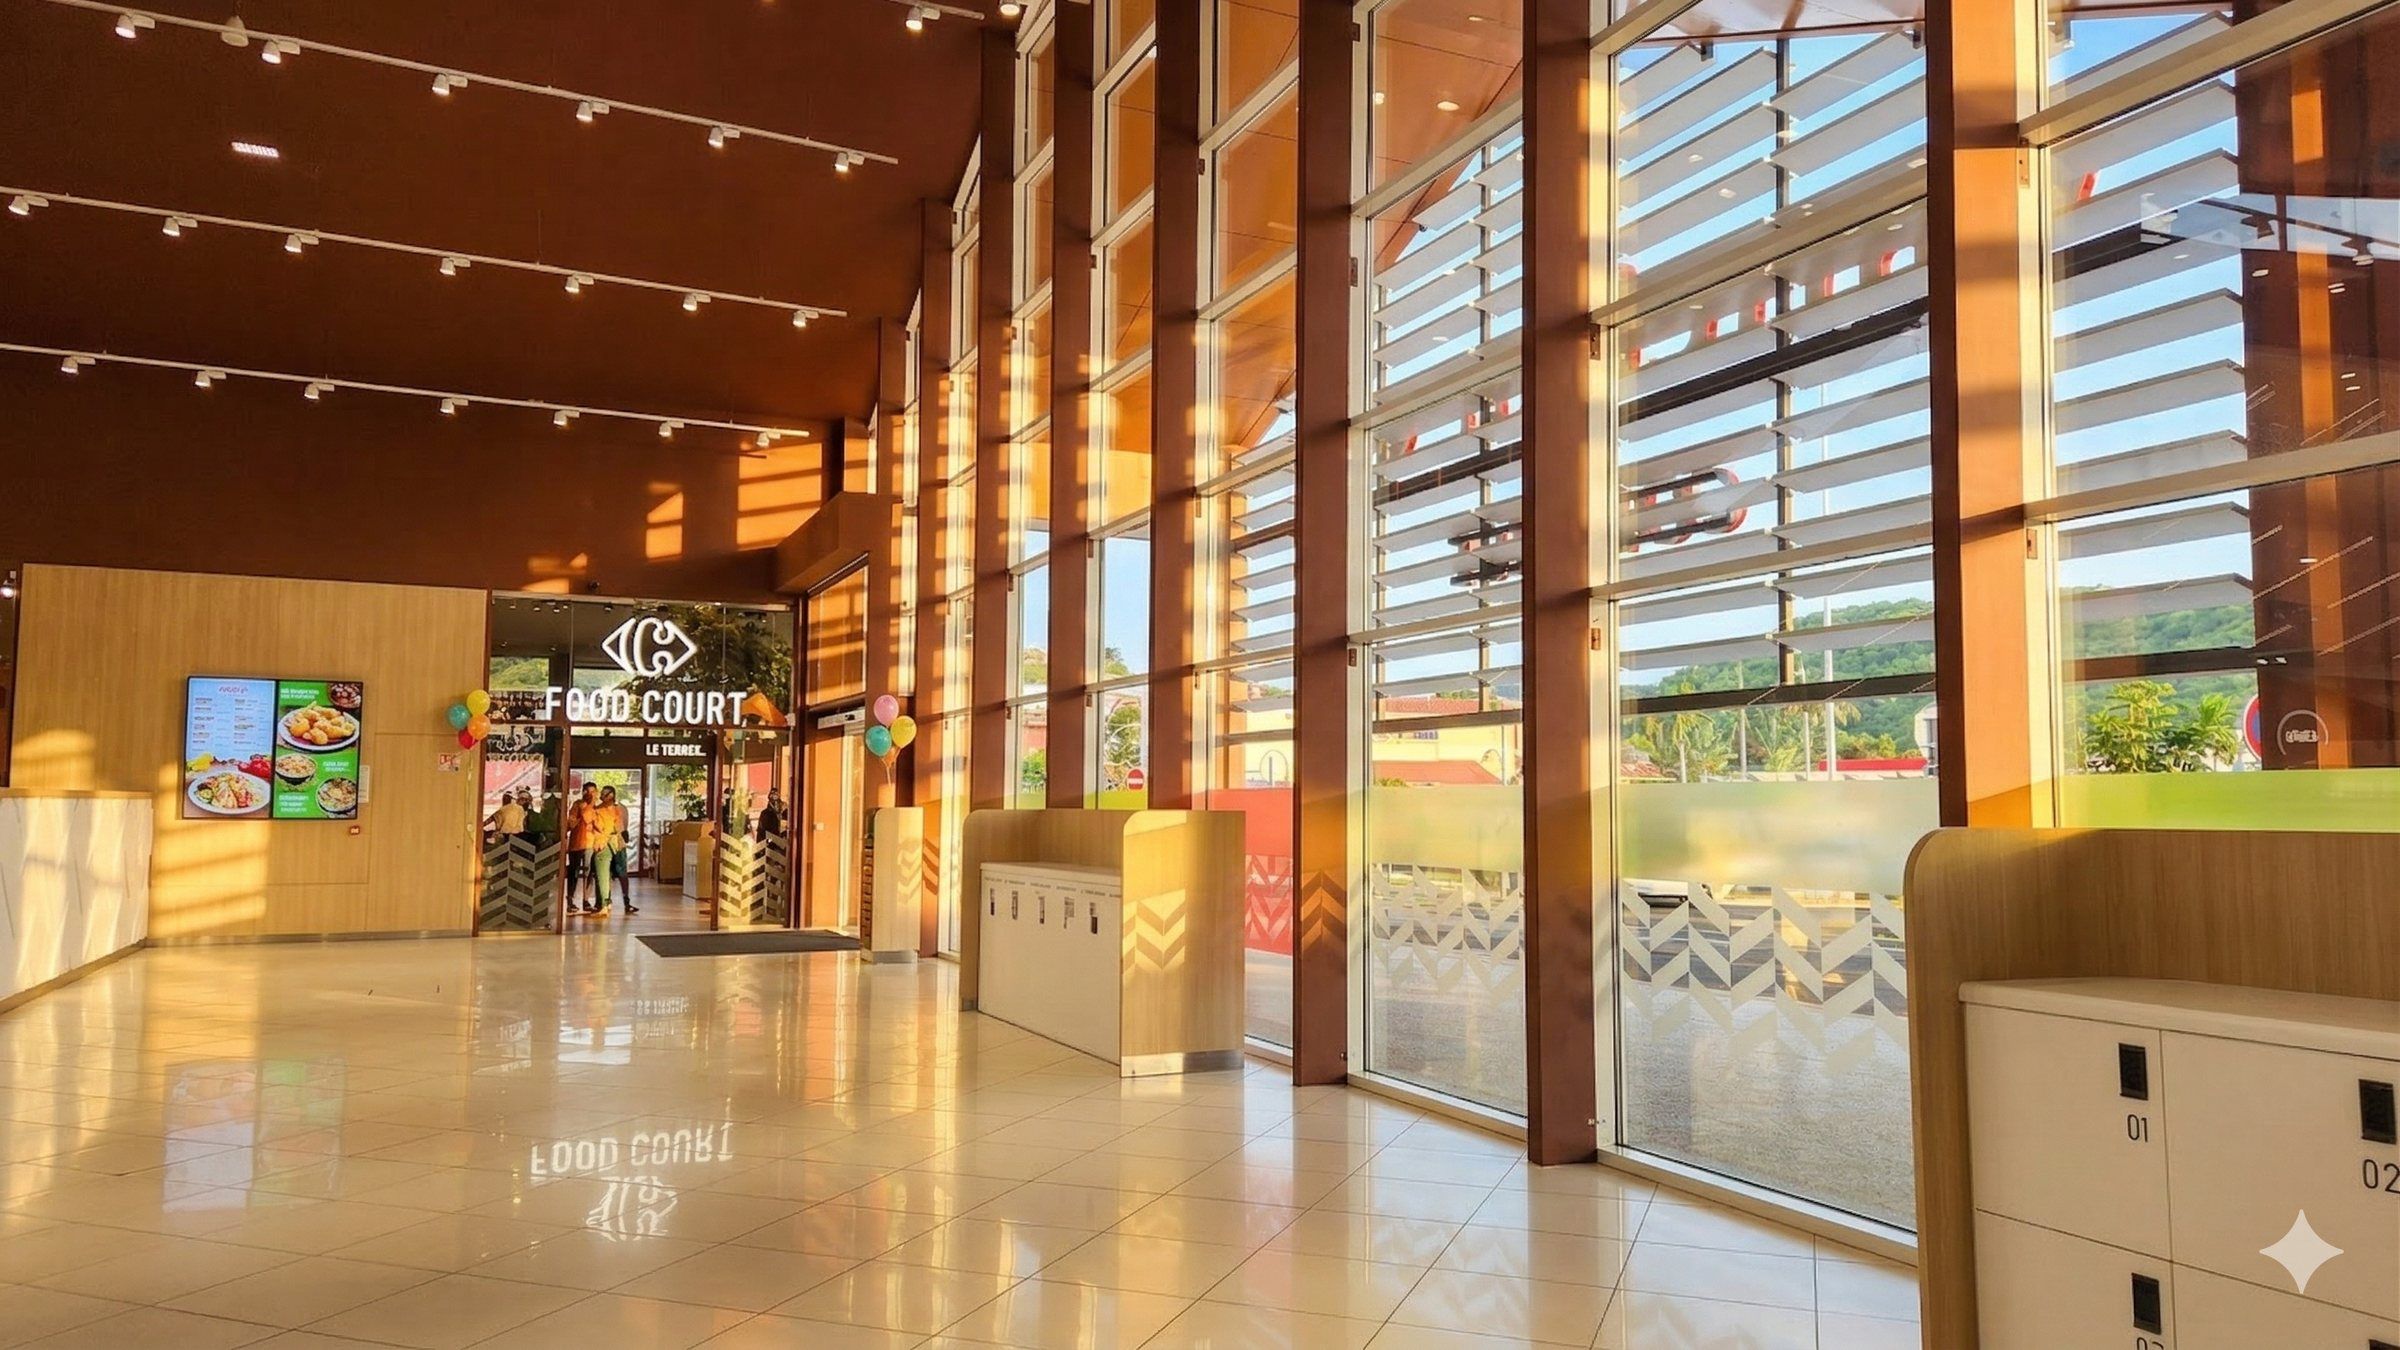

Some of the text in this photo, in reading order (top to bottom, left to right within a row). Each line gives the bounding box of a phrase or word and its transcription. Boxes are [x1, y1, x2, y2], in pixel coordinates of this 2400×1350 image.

[546, 686, 748, 726] FOOD COURT
[646, 744, 660, 756] LE
[2127, 1113, 2149, 1143] 01
[2362, 1158, 2400, 1194] 02
